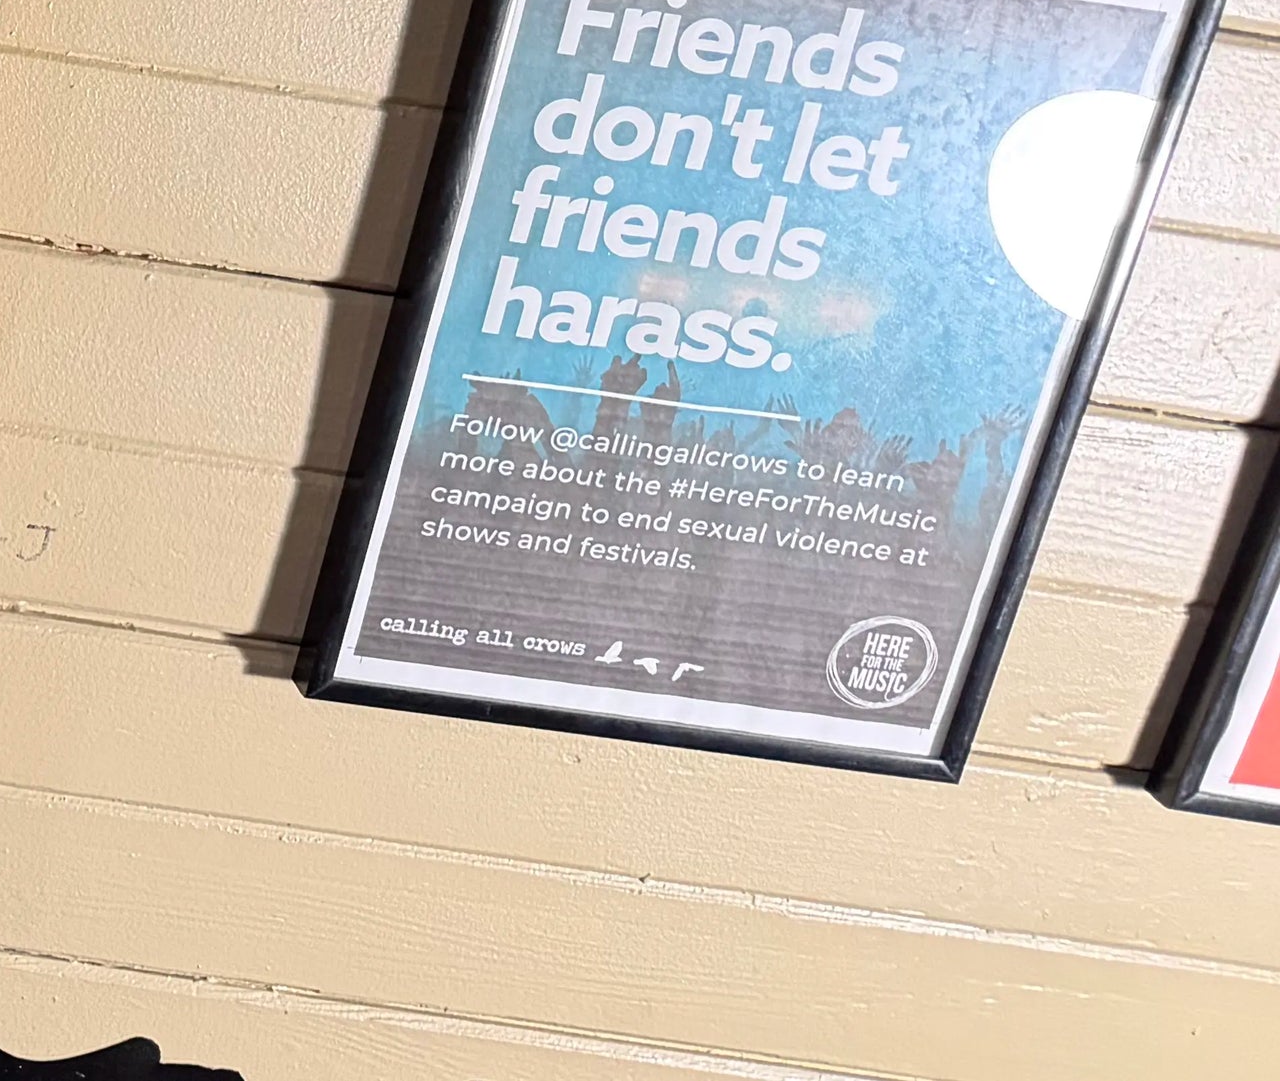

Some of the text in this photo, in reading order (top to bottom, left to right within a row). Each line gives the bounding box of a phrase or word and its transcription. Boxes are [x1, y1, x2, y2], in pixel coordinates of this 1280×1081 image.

[534, 73, 911, 196] don't let
[509, 165, 826, 282] friends
[481, 255, 794, 372] harass.
[440, 450, 937, 533] more about the #HereForTheMusic
[450, 413, 905, 493] Follow @callingallcrows to learn
[421, 518, 697, 571] shows and festivals.
[430, 485, 930, 567] campaign to end sexual violence at
[380, 617, 587, 657] calling all crows
[861, 654, 905, 672] FOR THE
[863, 631, 914, 659] HERE
[847, 666, 908, 698] MUSIC
